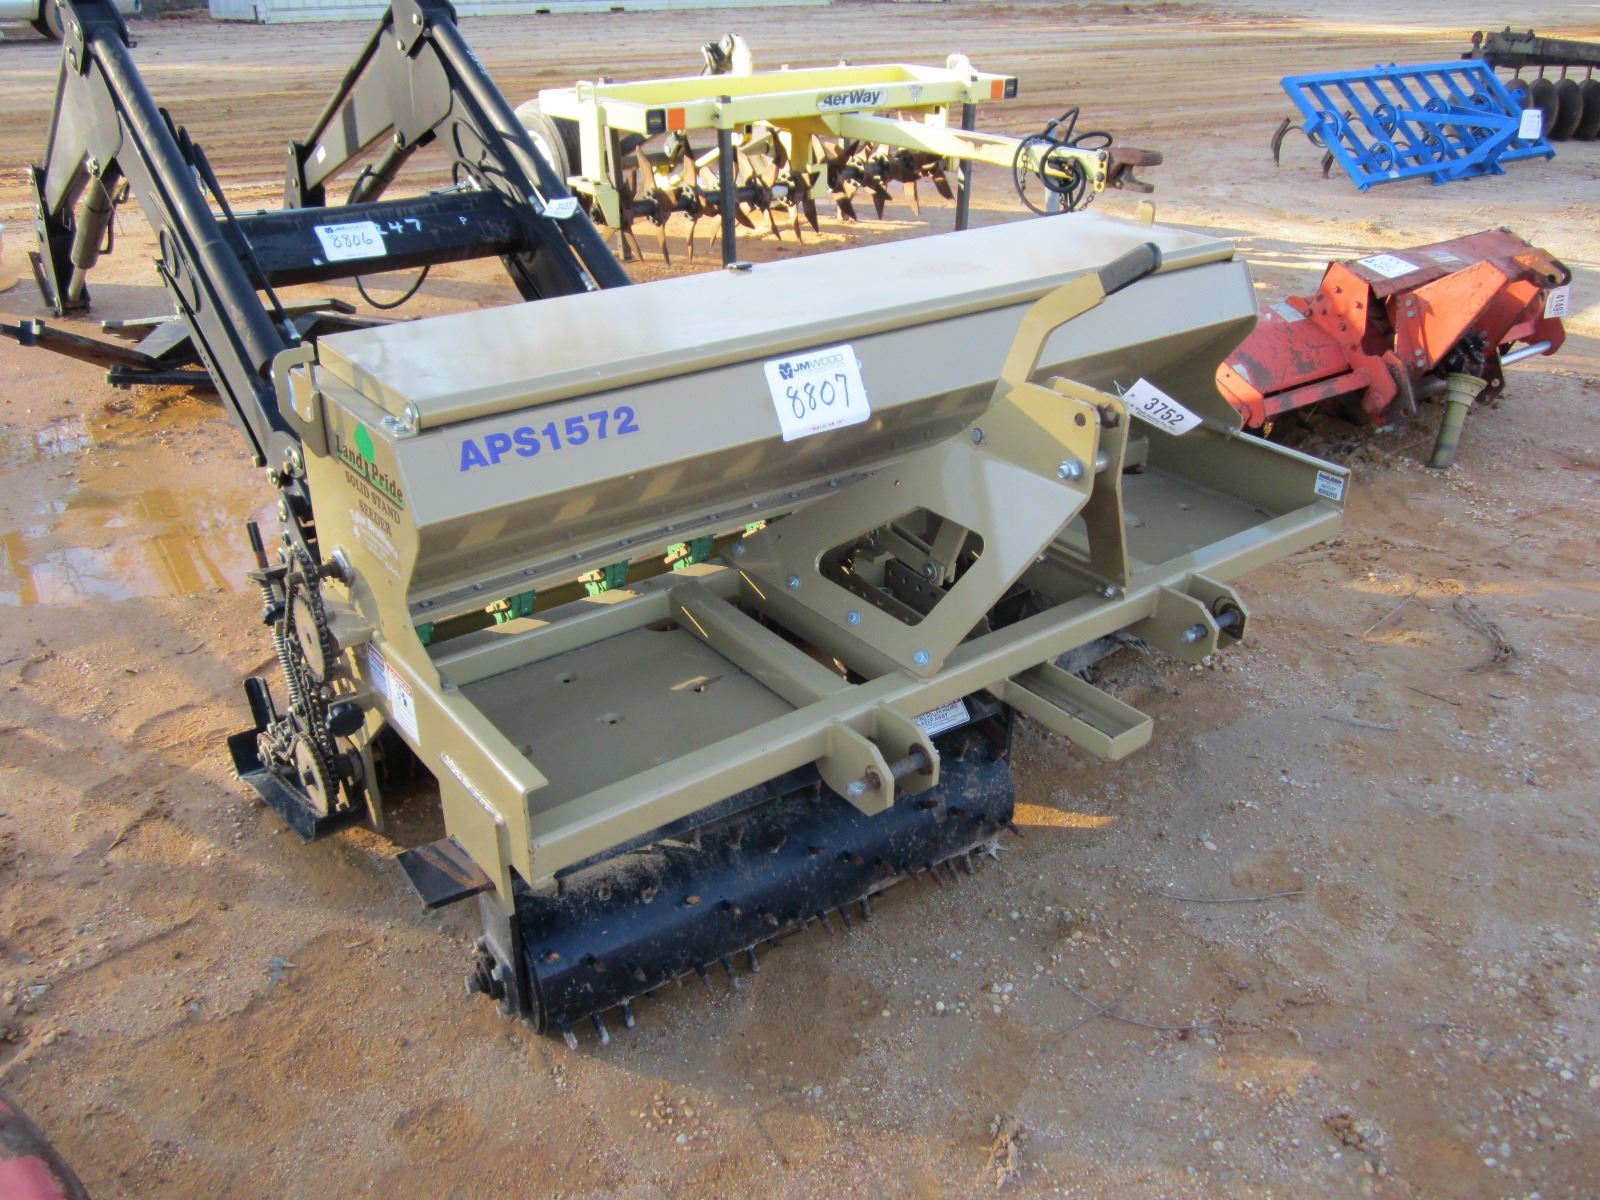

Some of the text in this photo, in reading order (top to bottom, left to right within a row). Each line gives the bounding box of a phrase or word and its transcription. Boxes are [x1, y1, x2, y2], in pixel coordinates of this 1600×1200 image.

[823, 88, 880, 105] AerWay
[330, 231, 373, 249] 8806
[786, 373, 849, 419] 8807
[1144, 397, 1185, 426] 3752
[460, 406, 640, 472] APS1572
[336, 434, 403, 503] Land Pride
[345, 470, 401, 525] SOLID STAND
[359, 499, 393, 537] SEEDER
